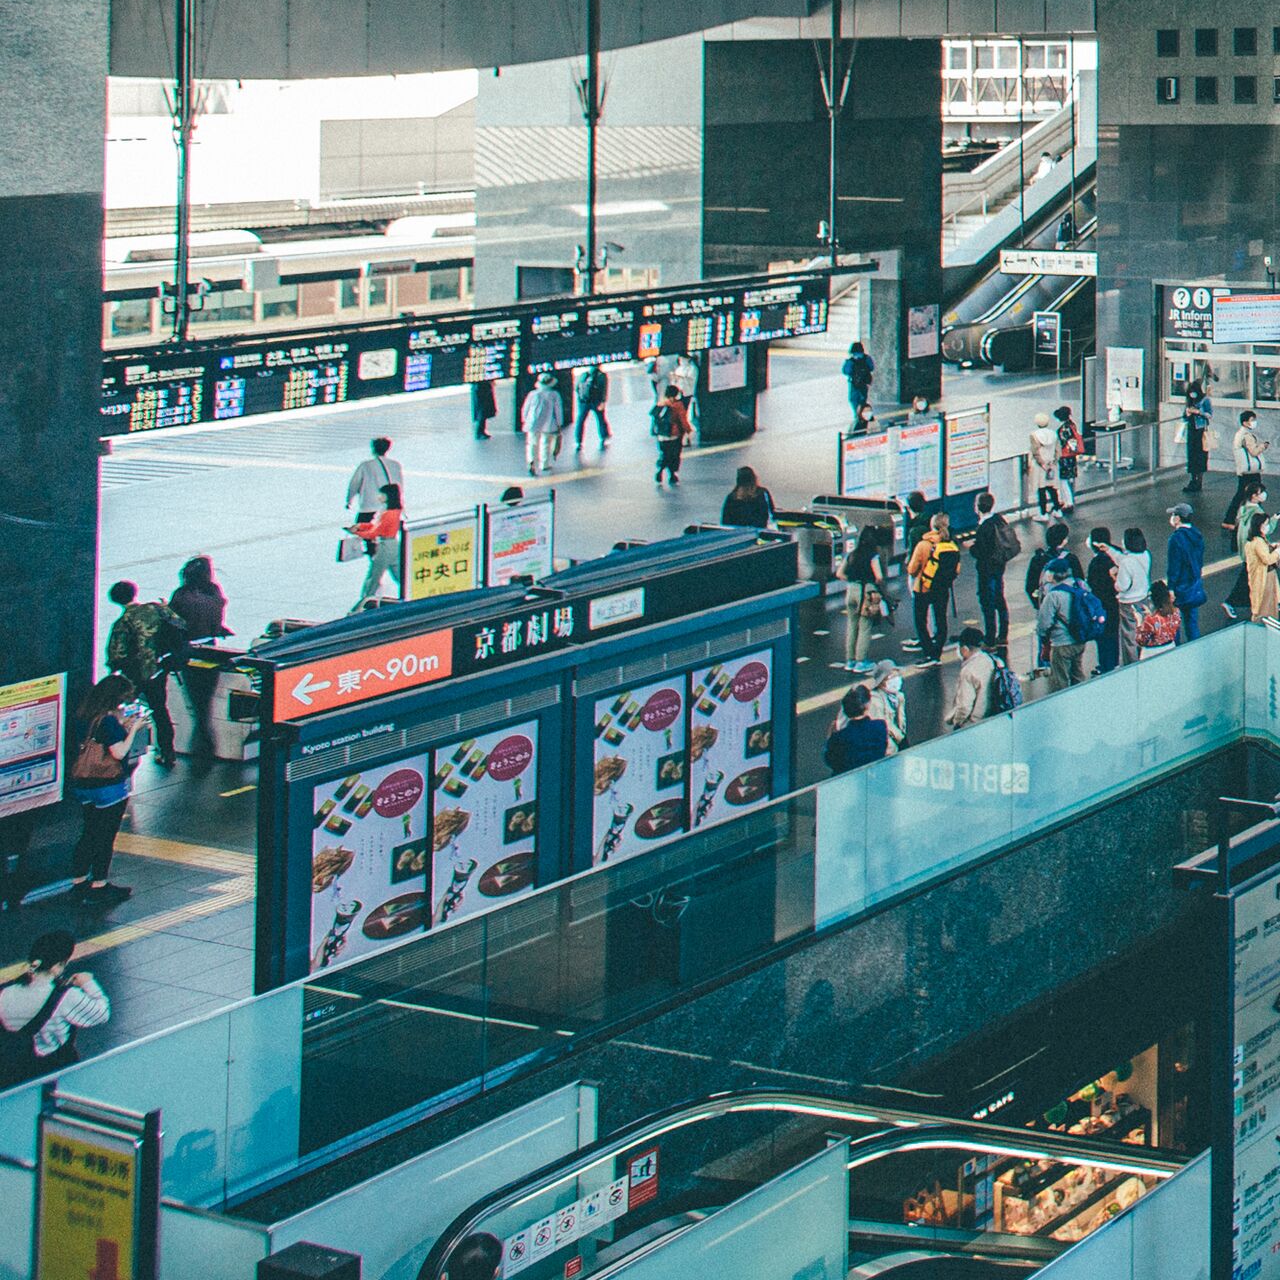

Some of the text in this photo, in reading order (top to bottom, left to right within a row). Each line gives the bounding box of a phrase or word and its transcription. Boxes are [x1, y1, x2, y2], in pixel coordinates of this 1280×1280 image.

[1169, 309, 1180, 320] JR
[415, 559, 468, 584] 中央口
[474, 606, 574, 660] 京都劇場
[336, 653, 440, 697] 東へ90m
[302, 722, 395, 755] Kyoto station building
[988, 1091, 1015, 1113] CAFE
